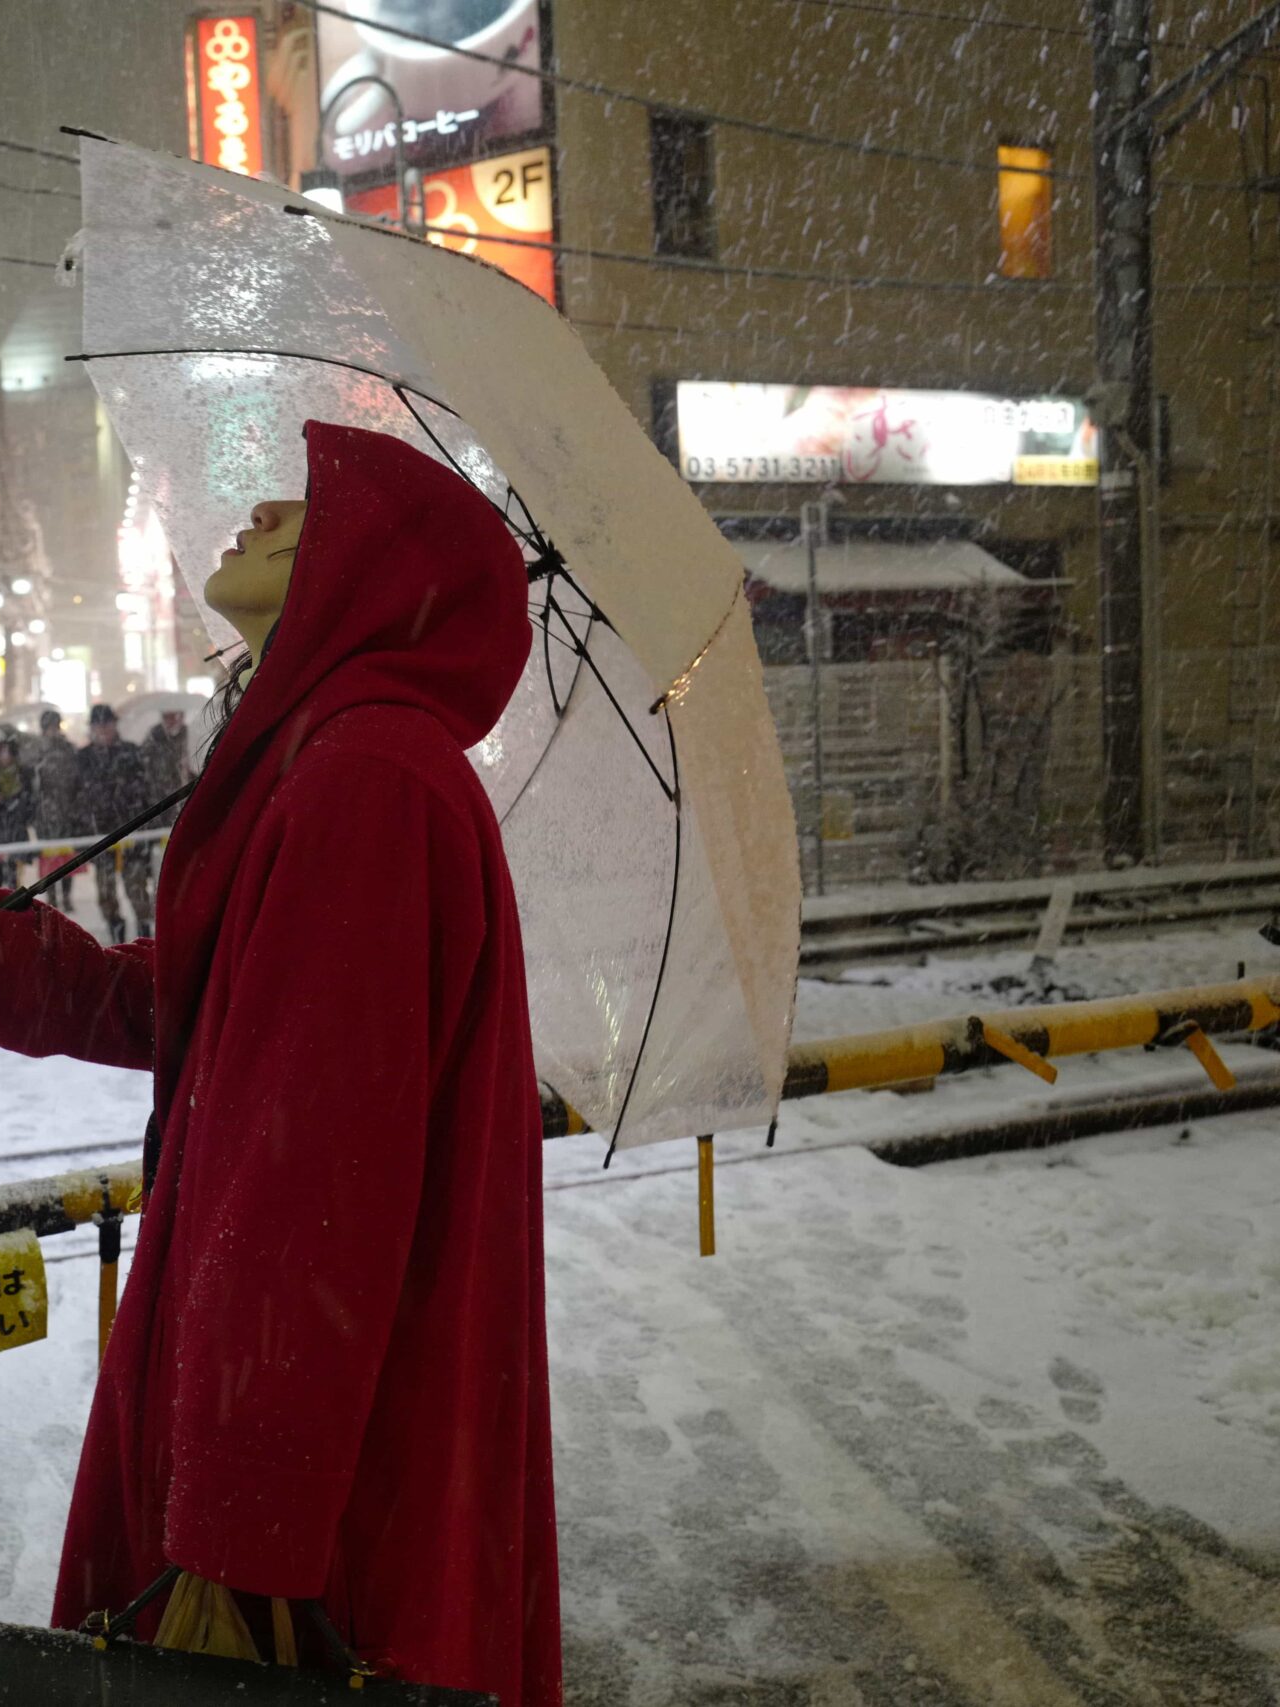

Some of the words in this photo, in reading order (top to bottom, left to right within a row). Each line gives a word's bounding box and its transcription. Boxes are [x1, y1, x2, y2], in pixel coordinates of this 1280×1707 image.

[333, 109, 479, 160] モリバコーヒー
[494, 161, 545, 206] 2F
